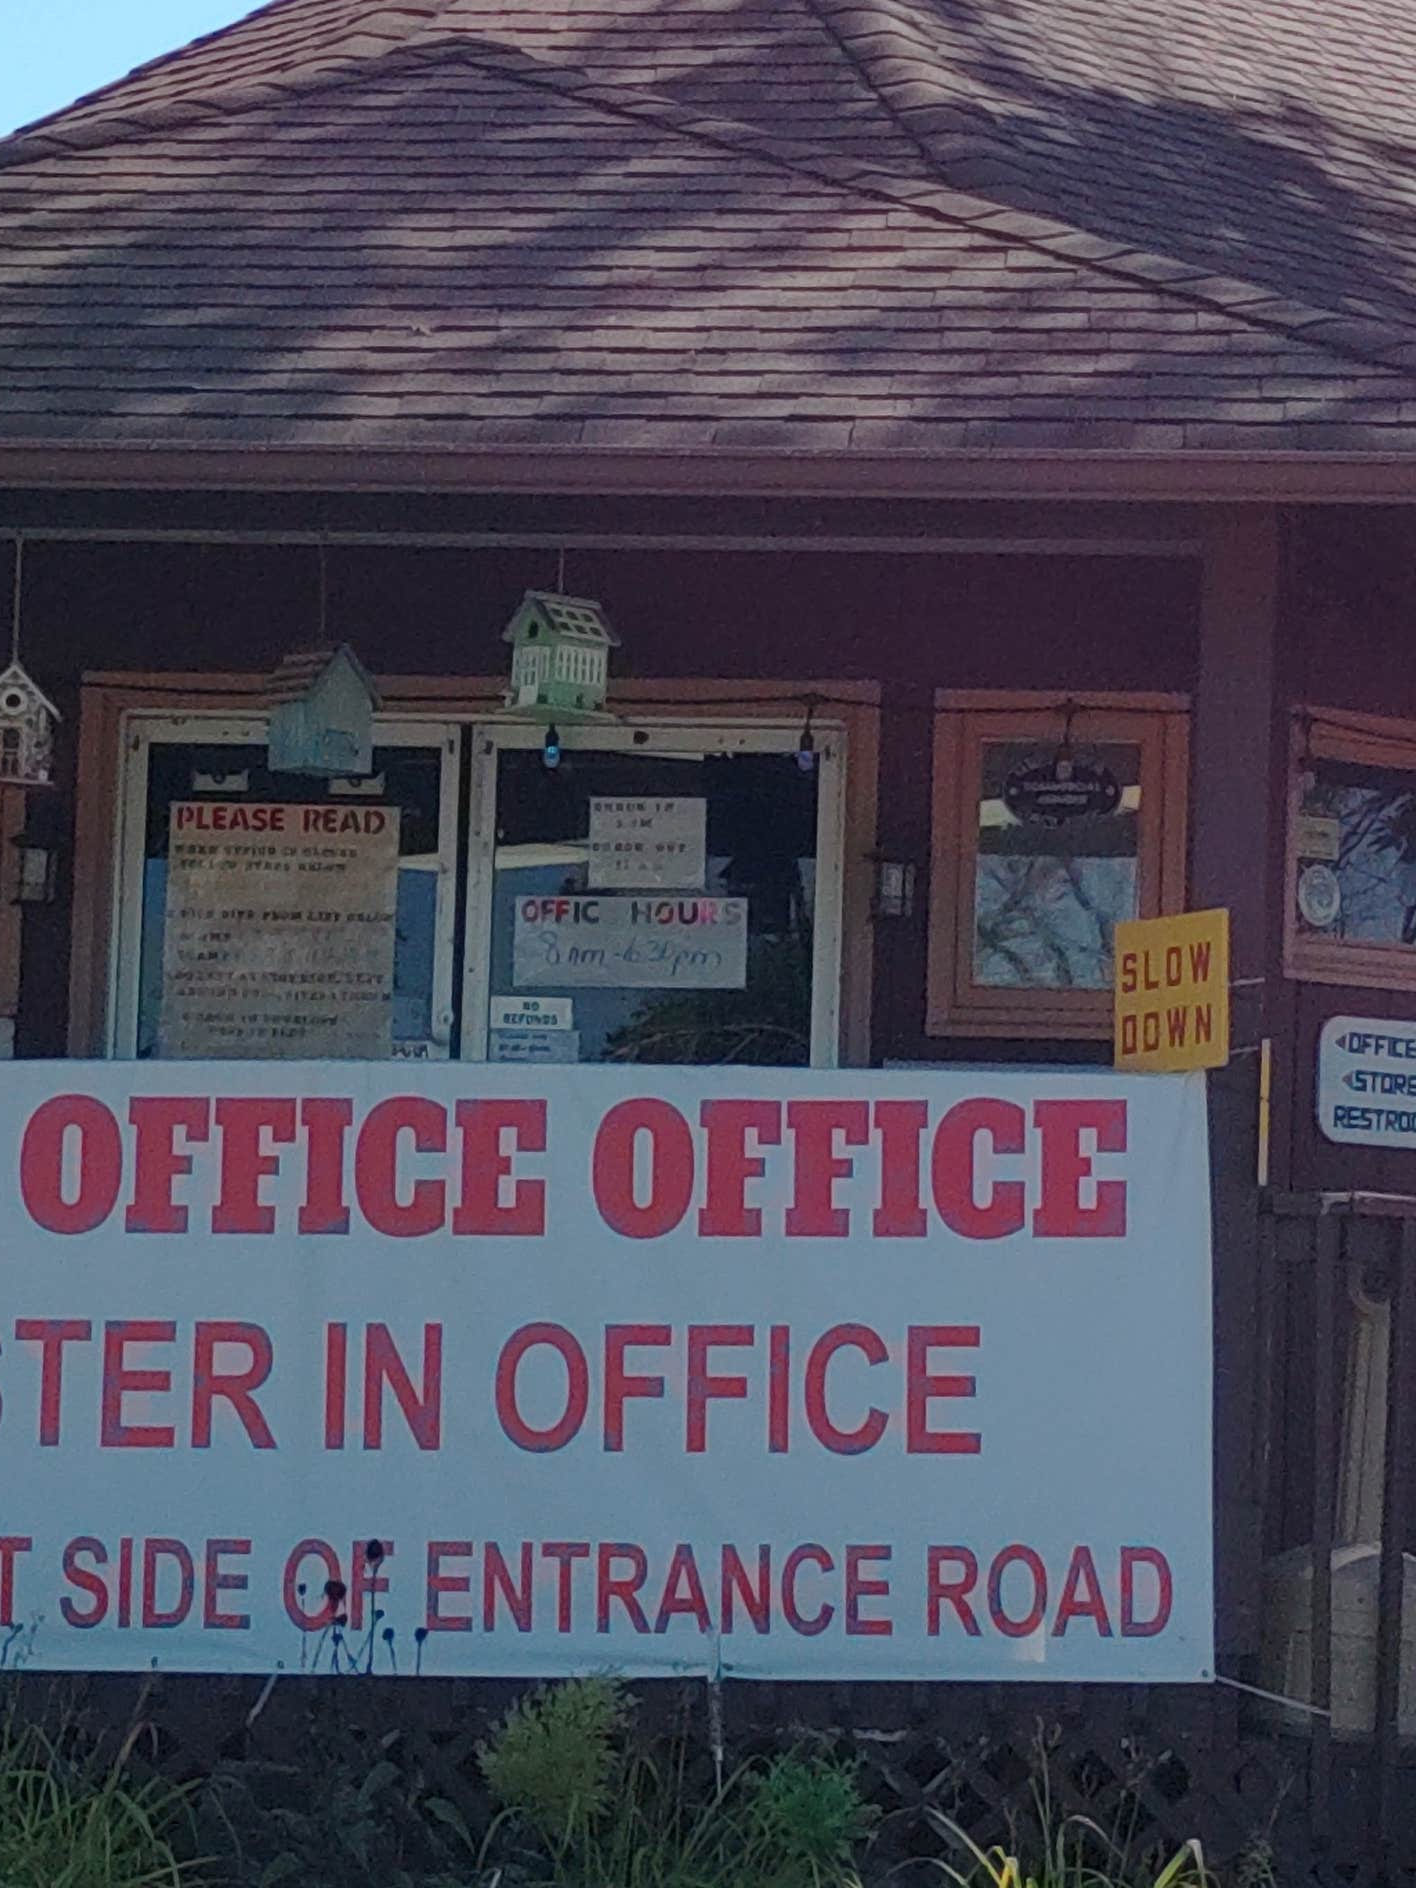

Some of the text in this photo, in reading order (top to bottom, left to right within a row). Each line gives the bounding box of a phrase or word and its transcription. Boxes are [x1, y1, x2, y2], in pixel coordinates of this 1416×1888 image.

[176, 806, 386, 835] PLEASE READ
[631, 901, 742, 926] HOURS
[1121, 941, 1212, 994] SLOW
[1122, 1003, 1213, 1056] DOWN
[19, 1094, 548, 1238] OFFICE
[591, 1097, 1128, 1240] OFFICE
[324, 1322, 443, 1451] IN
[495, 1322, 982, 1456] OFFICE
[59, 1536, 252, 1630] SIDE
[284, 1538, 394, 1632] OF
[426, 1540, 893, 1637] ENTRANCE
[927, 1544, 1173, 1639] ROAD
